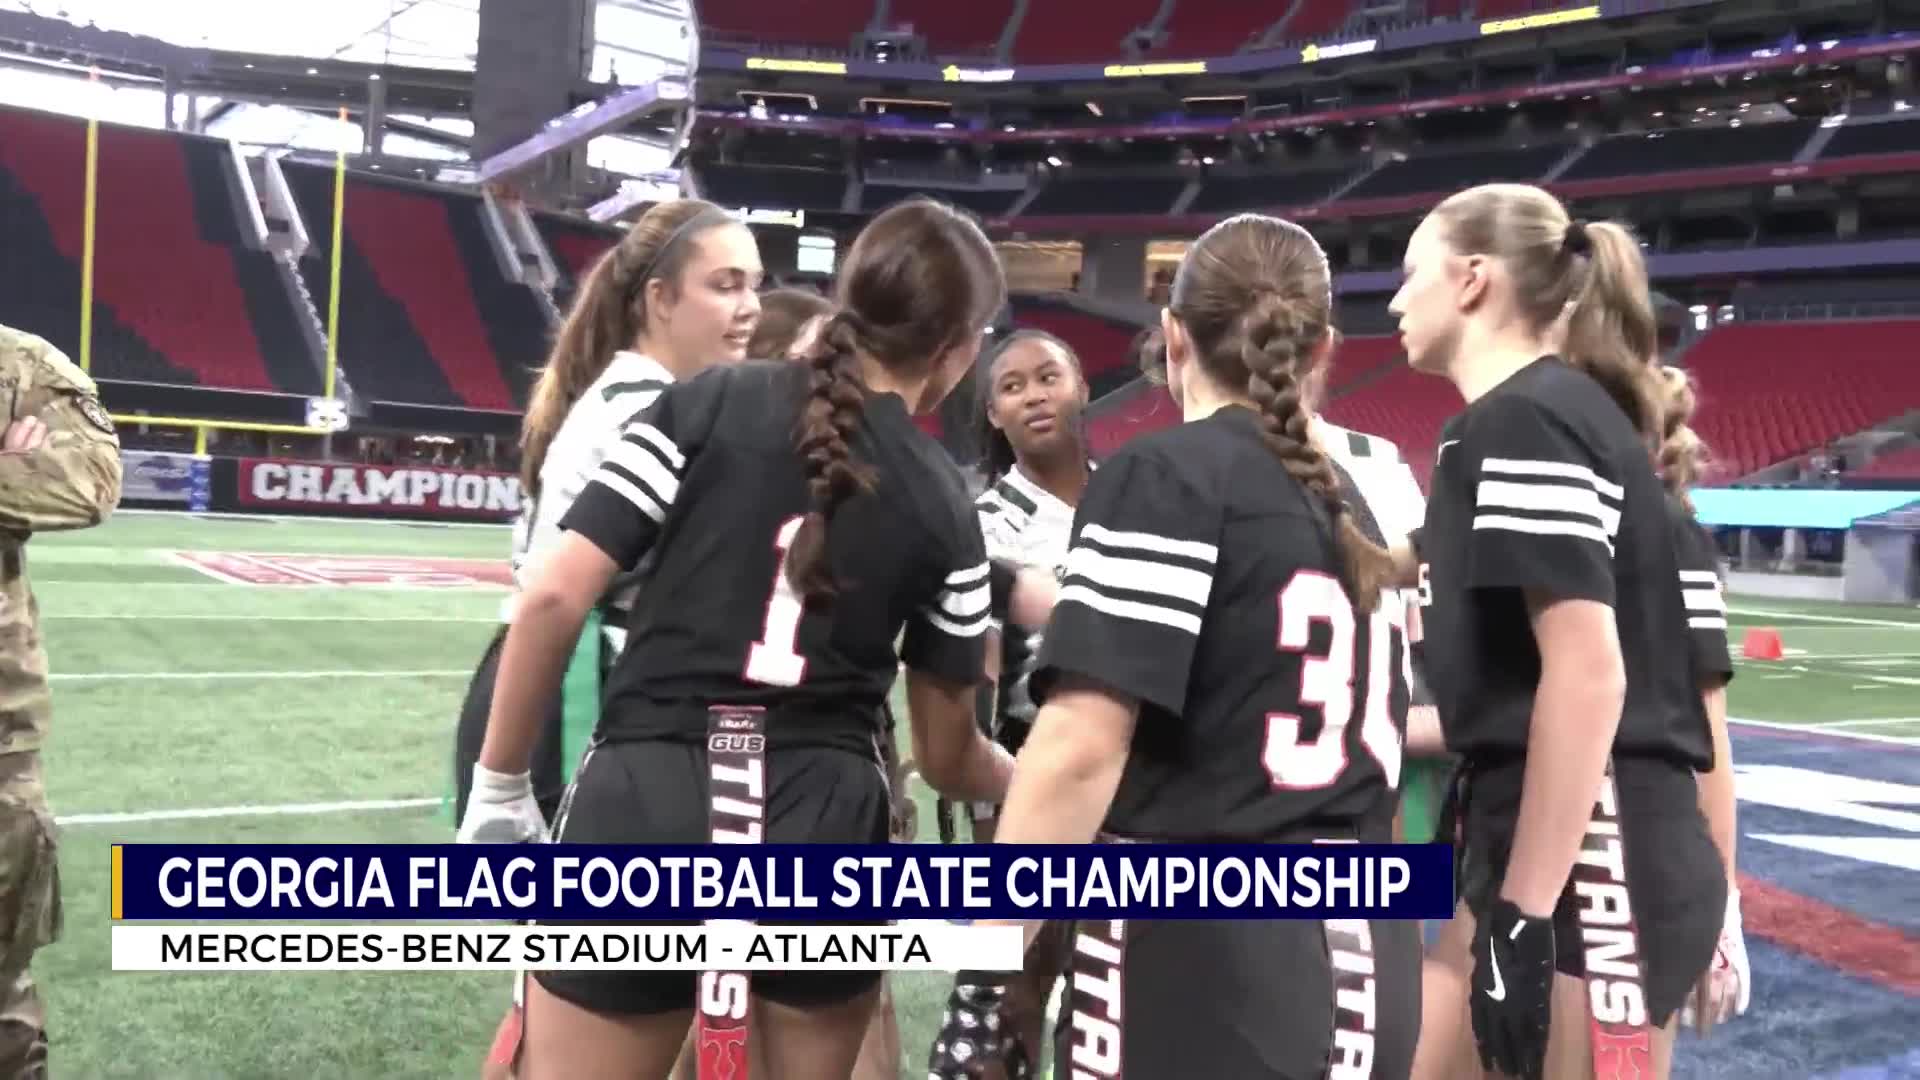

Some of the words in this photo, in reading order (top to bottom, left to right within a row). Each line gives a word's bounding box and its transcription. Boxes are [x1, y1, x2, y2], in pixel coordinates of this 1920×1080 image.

[745, 514, 807, 687] 1
[1260, 568, 1415, 790] 30
[708, 733, 766, 752] GUS
